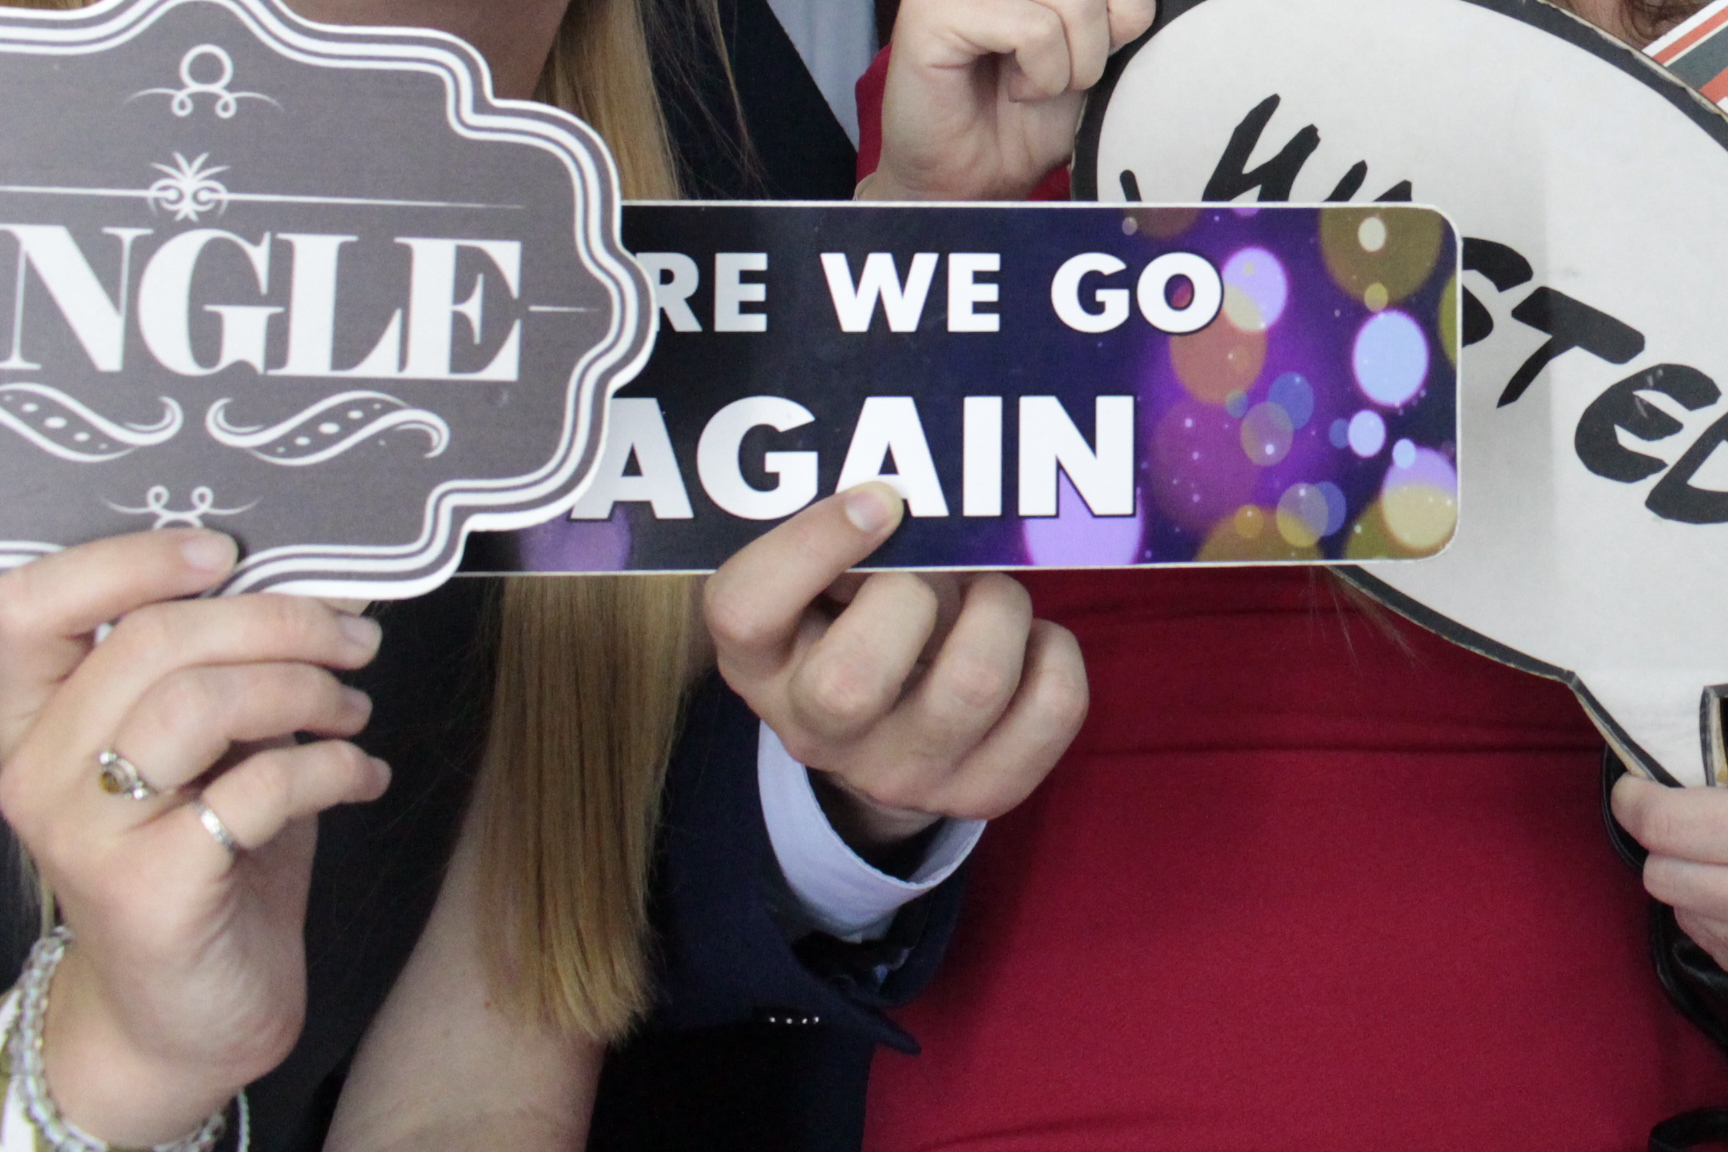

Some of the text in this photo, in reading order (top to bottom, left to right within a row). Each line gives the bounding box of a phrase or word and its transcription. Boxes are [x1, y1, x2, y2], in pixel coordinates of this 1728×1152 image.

[0, 223, 522, 382] NGLE
[819, 251, 1001, 333] WE
[1050, 250, 1223, 334] GO
[569, 394, 1136, 521] AGAIN
